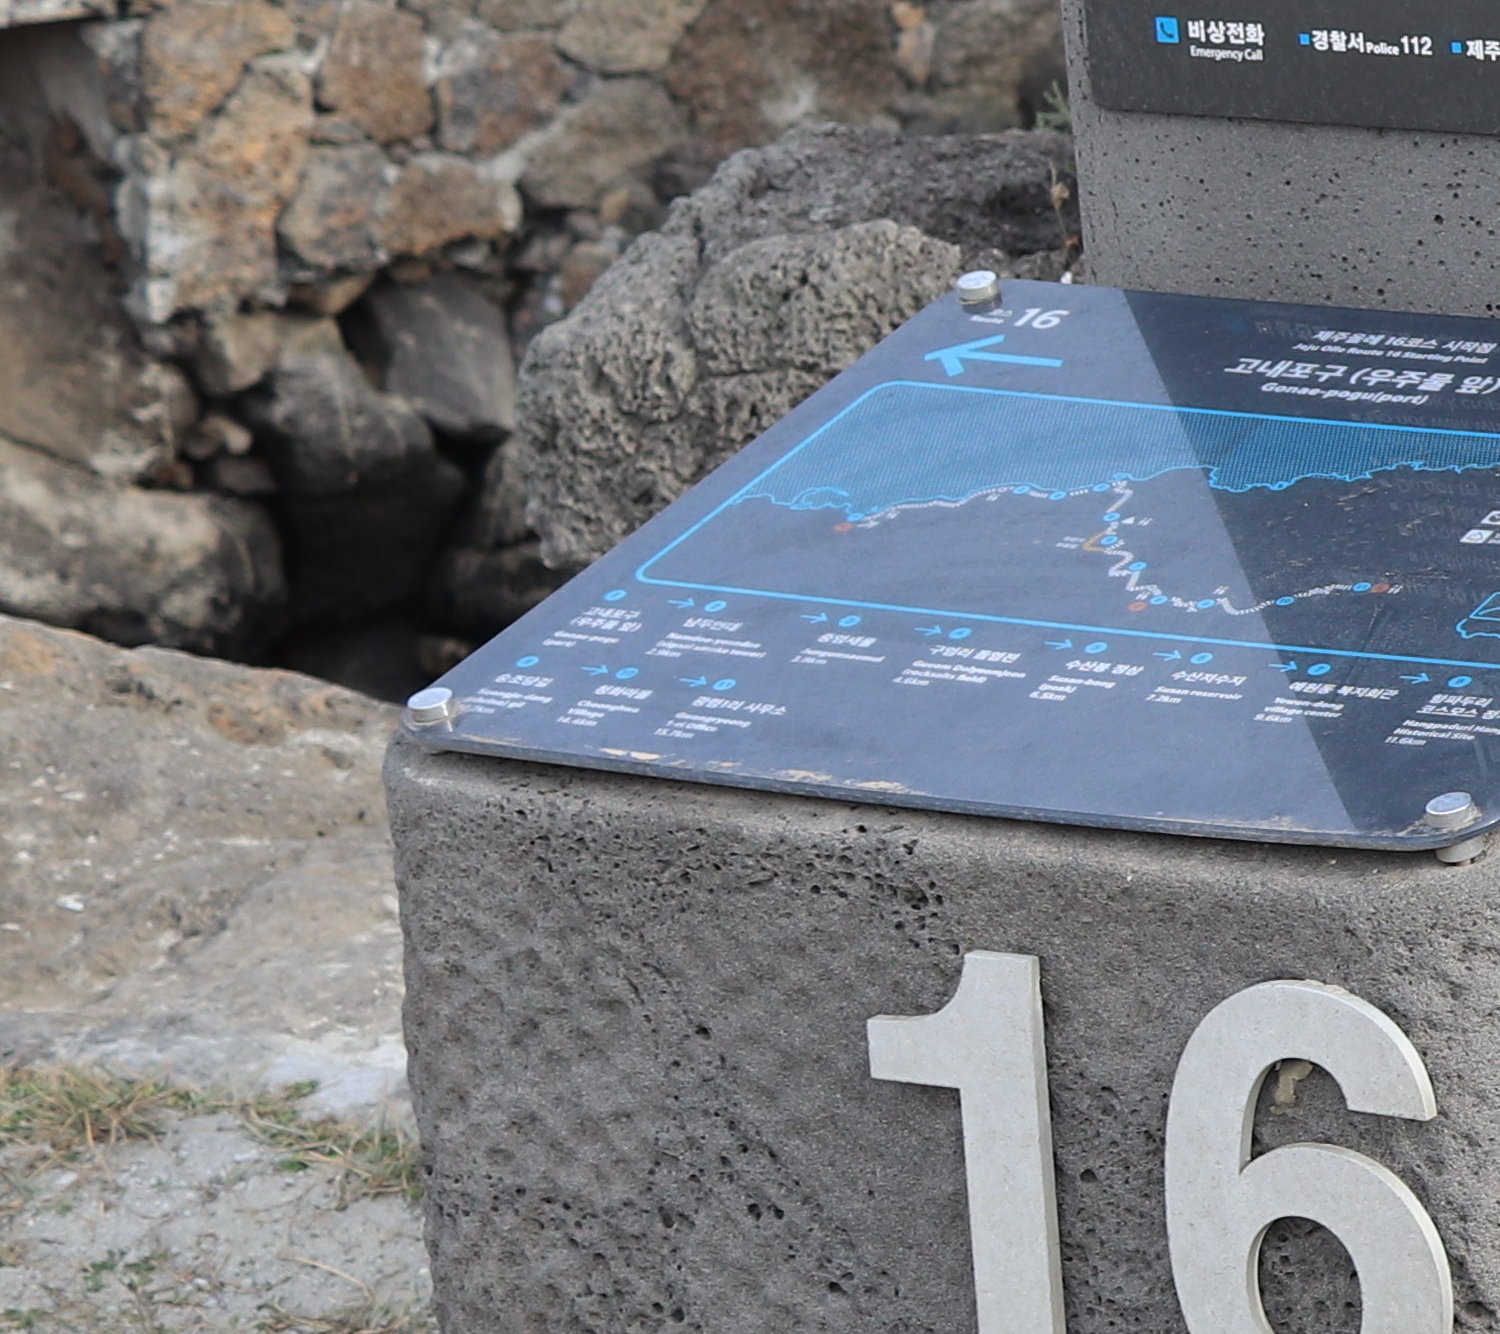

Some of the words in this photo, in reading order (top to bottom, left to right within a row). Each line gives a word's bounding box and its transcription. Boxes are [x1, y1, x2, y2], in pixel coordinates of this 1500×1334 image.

[1187, 20, 1264, 46] 비상전화
[1312, 29, 1365, 53] 경찰서
[1366, 43, 1399, 56] Police
[1401, 35, 1433, 56] 112
[1013, 308, 1069, 329] 16
[1224, 358, 1347, 380] 고내포구
[1350, 368, 1455, 391] (우주물
